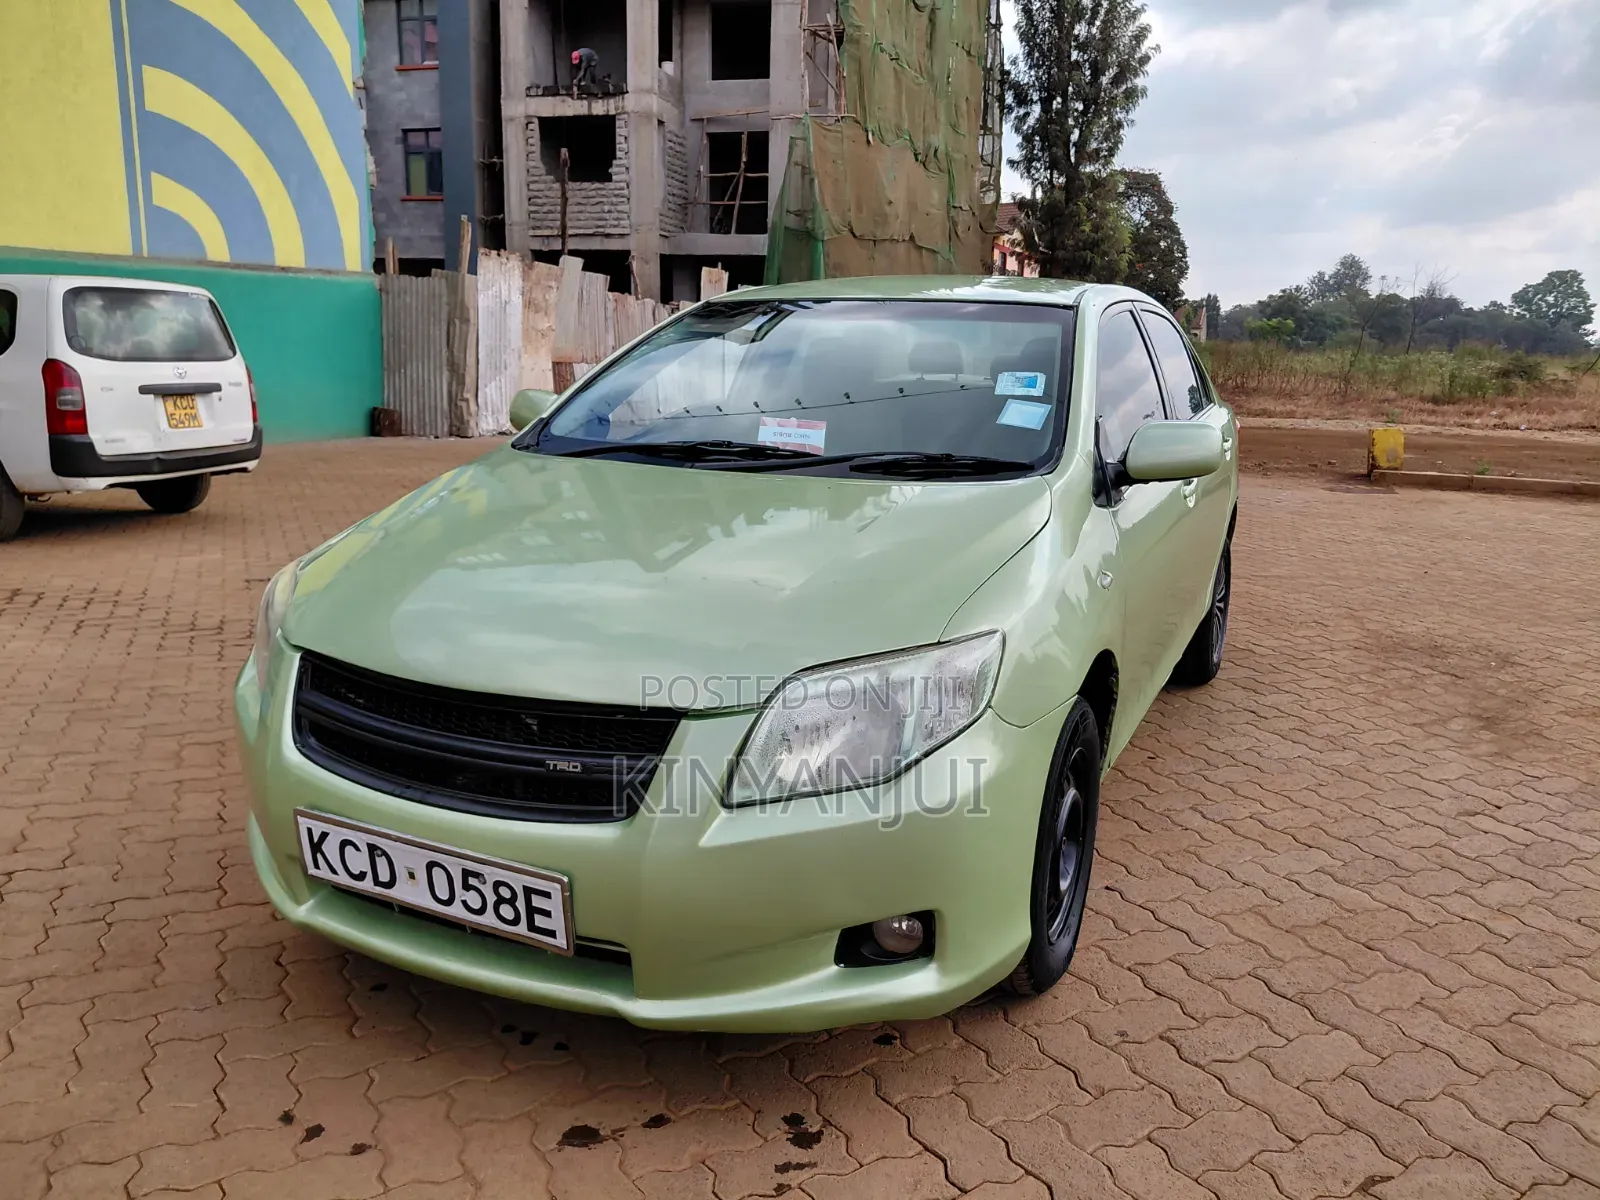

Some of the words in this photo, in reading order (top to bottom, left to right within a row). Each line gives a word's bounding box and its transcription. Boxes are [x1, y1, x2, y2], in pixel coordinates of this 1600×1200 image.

[170, 412, 201, 428] 549M
[545, 760, 582, 772] TRD
[306, 826, 398, 890] KCD
[425, 860, 557, 940] 058E
